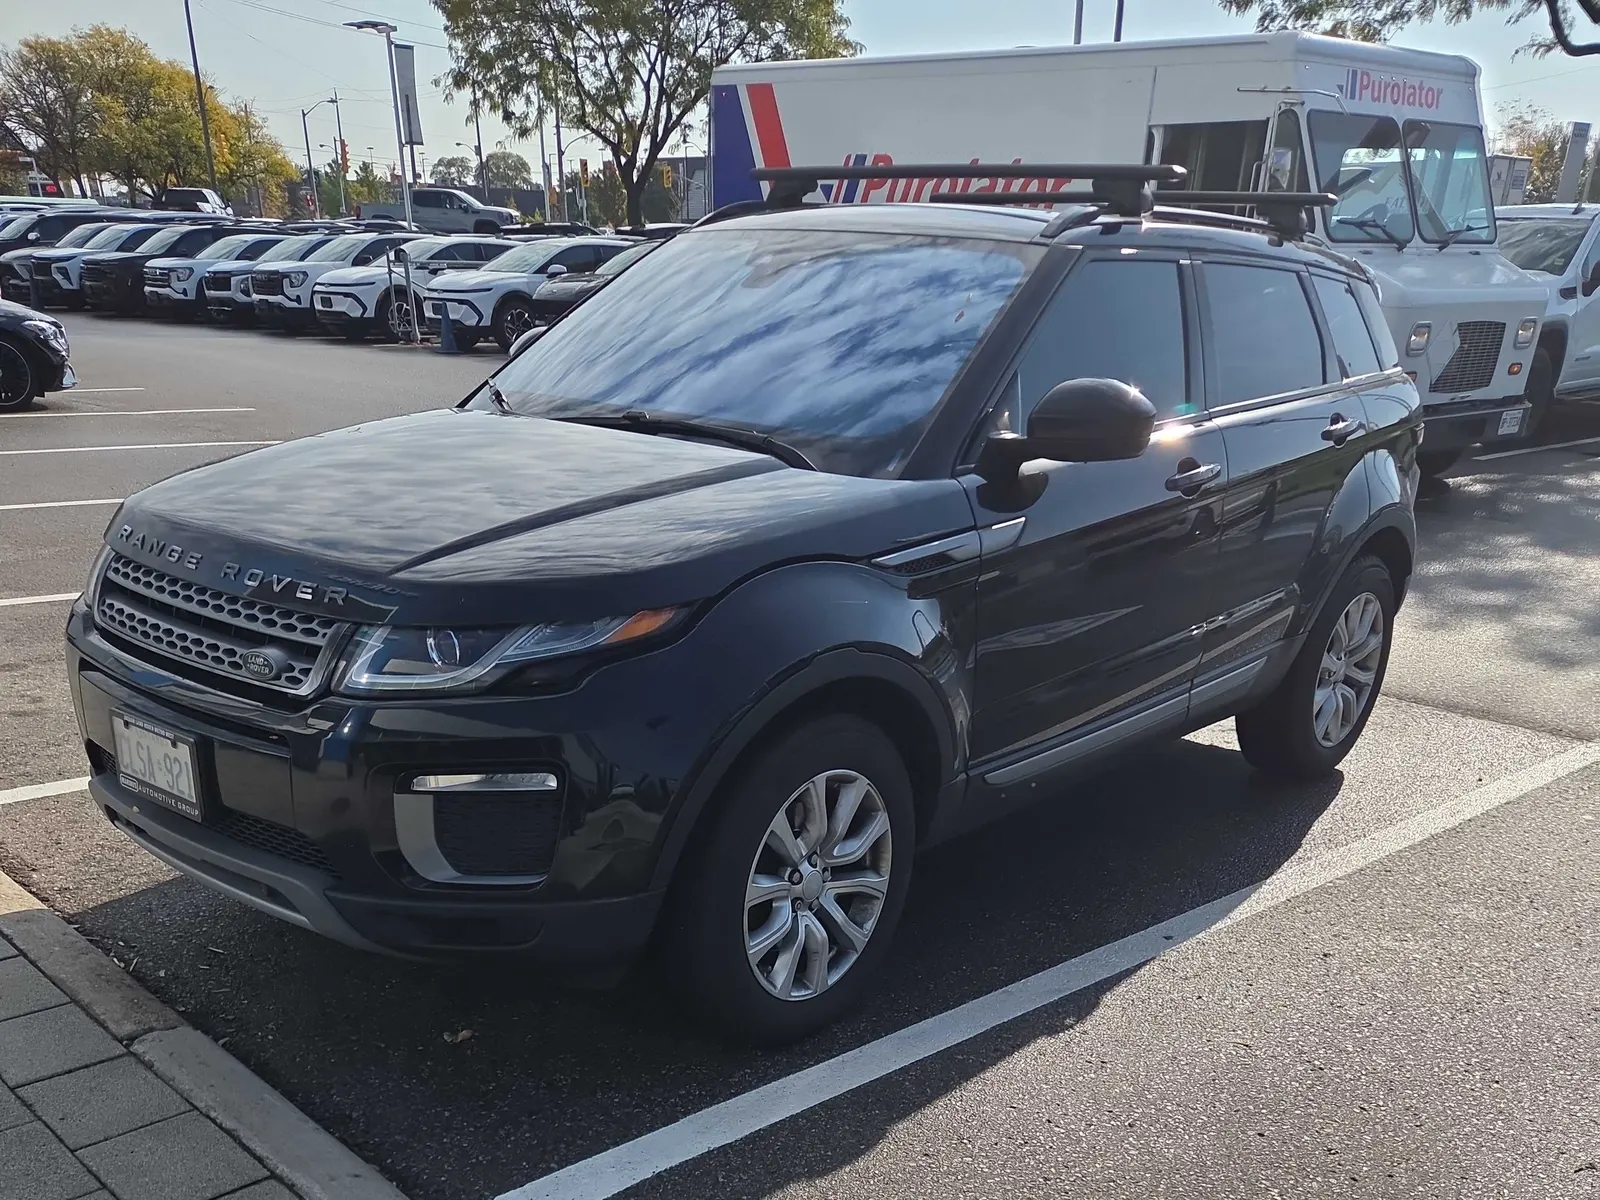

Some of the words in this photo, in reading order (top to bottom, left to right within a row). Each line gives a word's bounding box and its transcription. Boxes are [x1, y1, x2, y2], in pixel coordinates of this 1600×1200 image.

[1358, 70, 1444, 109] Purolator
[117, 524, 203, 571] RANGE
[219, 561, 349, 605] ROVER
[248, 655, 264, 666] LAND
[249, 663, 270, 675] ROVER
[139, 783, 176, 807] AUTOMOTIVE
[177, 801, 199, 816] GROUP
